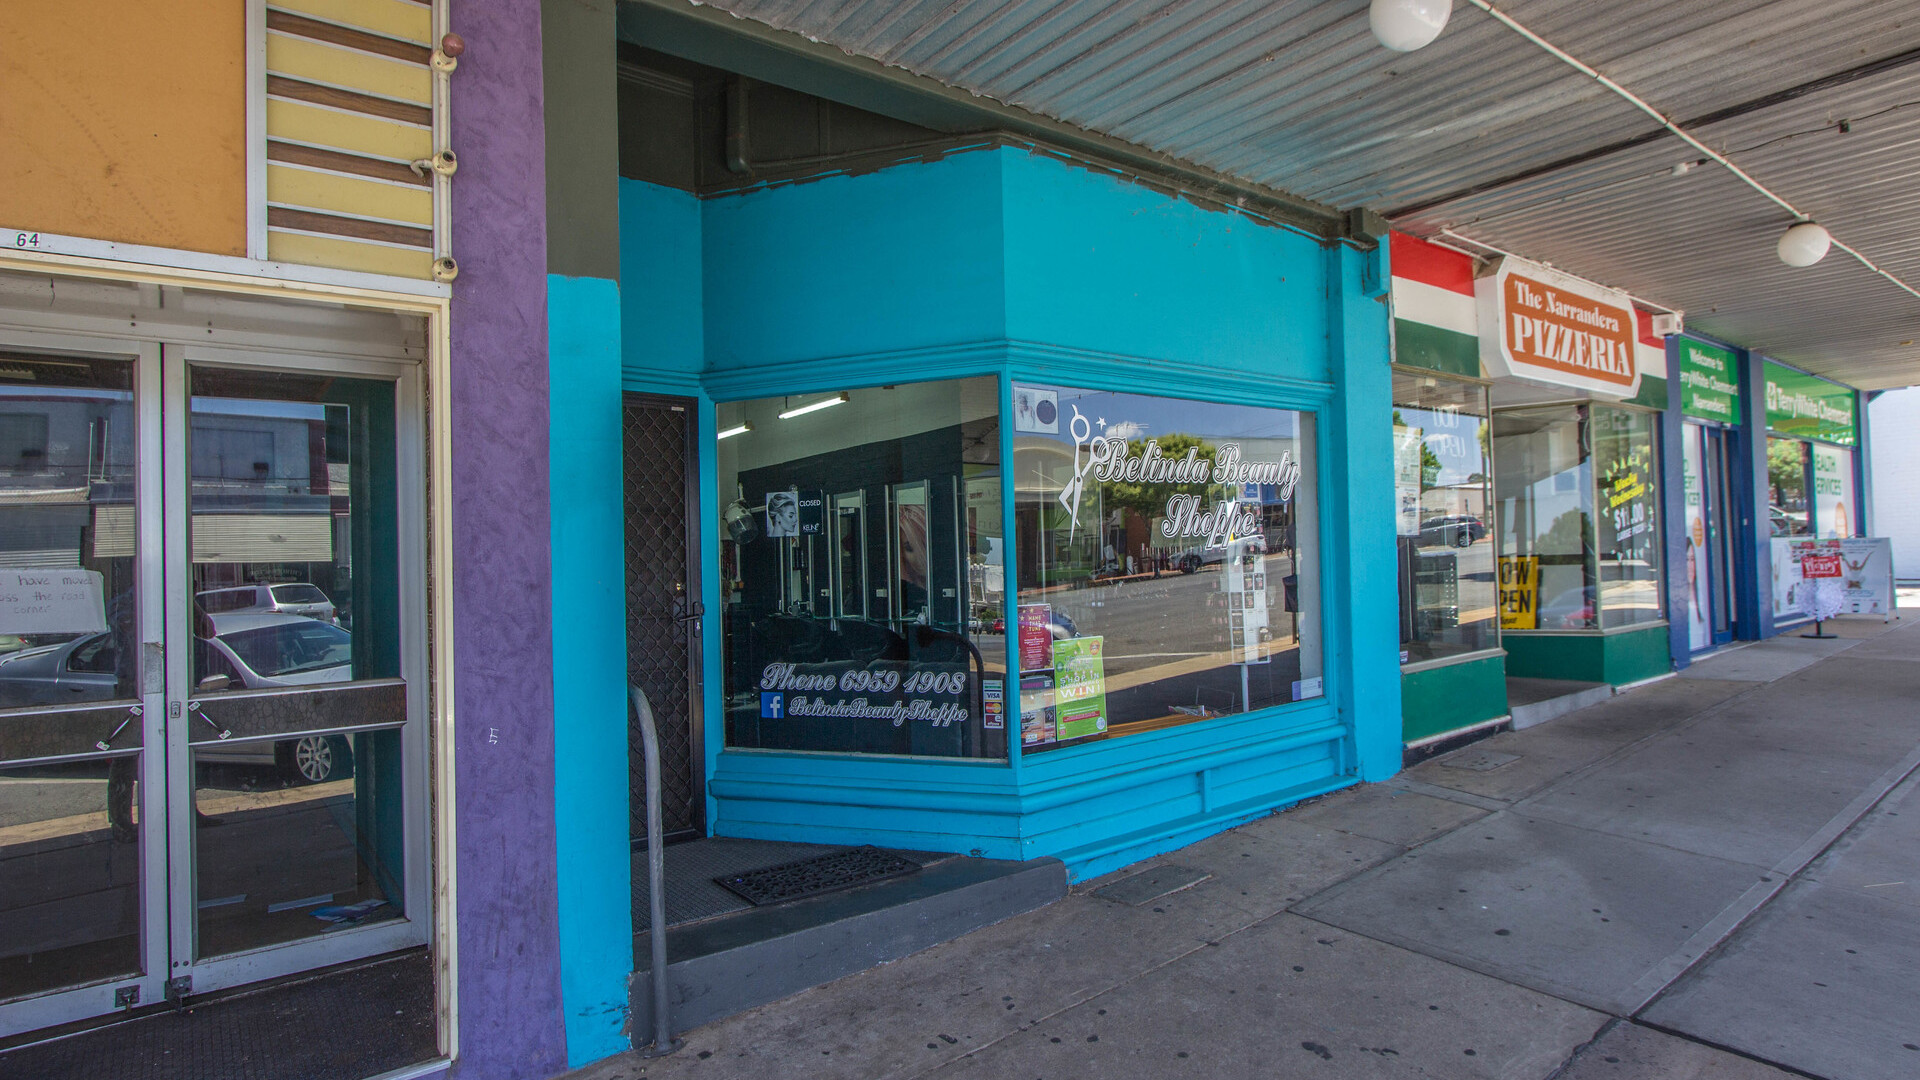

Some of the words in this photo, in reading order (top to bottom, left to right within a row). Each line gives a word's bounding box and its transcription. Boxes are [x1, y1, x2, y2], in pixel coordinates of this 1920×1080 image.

[17, 233, 39, 246] 64
[1514, 280, 1542, 309] The
[1546, 291, 1620, 333] Narrandera
[1512, 312, 1632, 377] PIZZERIA
[1689, 348, 1716, 369] Welcome
[1716, 358, 1724, 371] to
[1680, 370, 1709, 388] erryWhite
[1777, 387, 1818, 419] TerryWhite
[1094, 437, 1210, 484] Belinda
[1213, 443, 1300, 501] Beauty
[1816, 453, 1836, 472] EALTH
[1816, 477, 1842, 495] ERVICES
[1161, 494, 1255, 550] Shoppe
[1499, 561, 1531, 585] OW
[32, 591, 52, 601] the
[1500, 589, 1531, 613] PEN
[760, 662, 836, 691] Phone
[839, 669, 900, 693] 6959
[902, 671, 966, 695] 1908
[788, 696, 968, 726] BelindaBeautyShoppe
